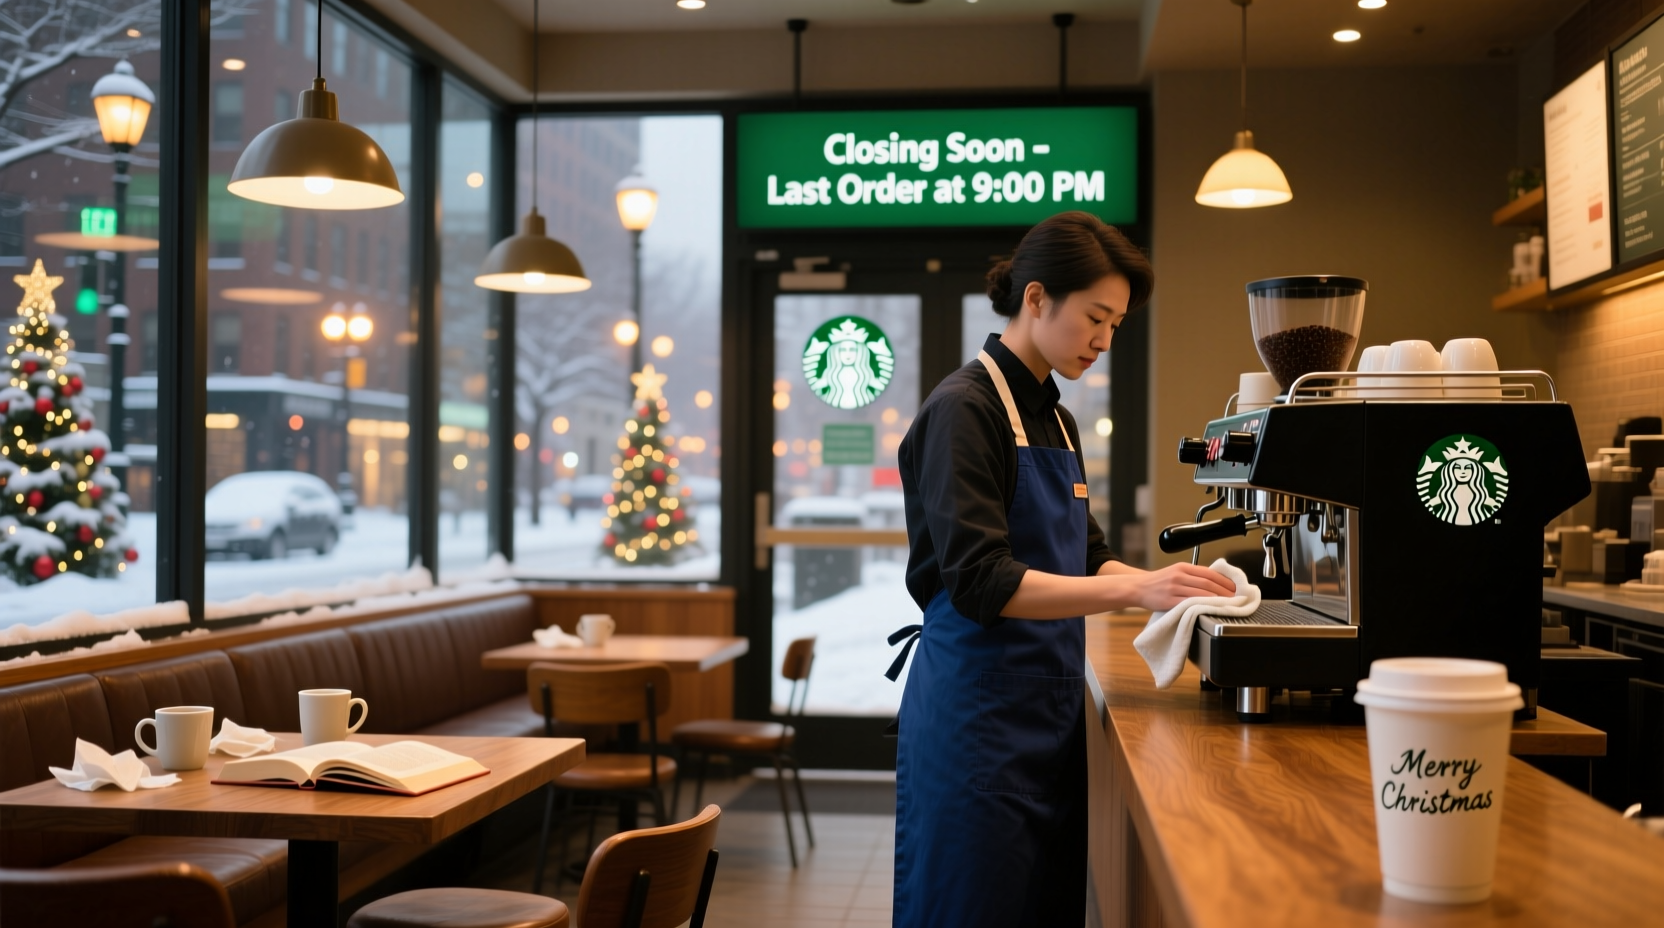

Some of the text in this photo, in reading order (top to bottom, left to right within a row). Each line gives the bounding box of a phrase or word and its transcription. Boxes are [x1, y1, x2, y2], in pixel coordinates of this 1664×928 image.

[823, 132, 939, 172] Closing
[945, 131, 1025, 164] Soon
[767, 170, 1105, 205] Last Order at 9:00 PM
[1391, 749, 1482, 790] Merry
[1382, 780, 1493, 814] Christmas
